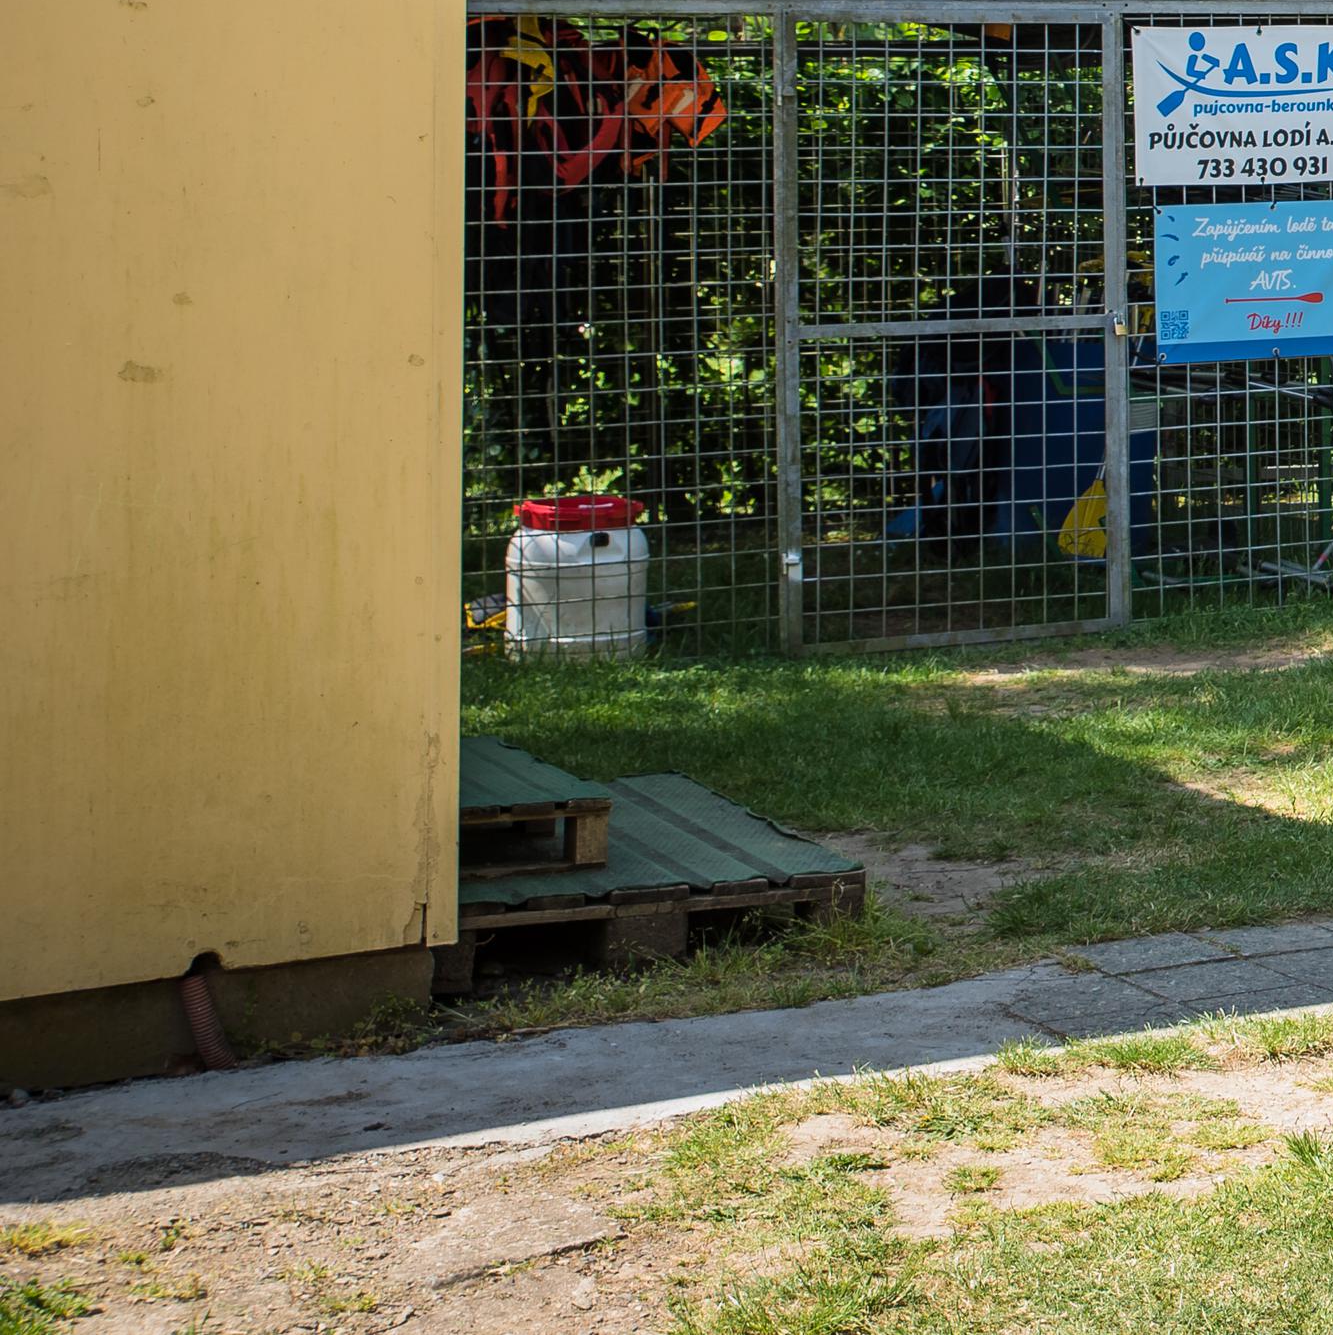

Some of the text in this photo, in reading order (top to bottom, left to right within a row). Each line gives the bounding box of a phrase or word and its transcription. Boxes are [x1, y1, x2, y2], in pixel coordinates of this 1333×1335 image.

[1149, 123, 1257, 150] PŮJČOVNA
[1262, 121, 1311, 147] LODÍ
[1197, 156, 1328, 180] 733 430 931
[1192, 217, 1281, 241] Zapůjčením
[1286, 215, 1317, 233] lodě
[1200, 245, 1266, 269] přispíváš
[1270, 250, 1292, 261] na
[1250, 269, 1296, 290] AVTS.
